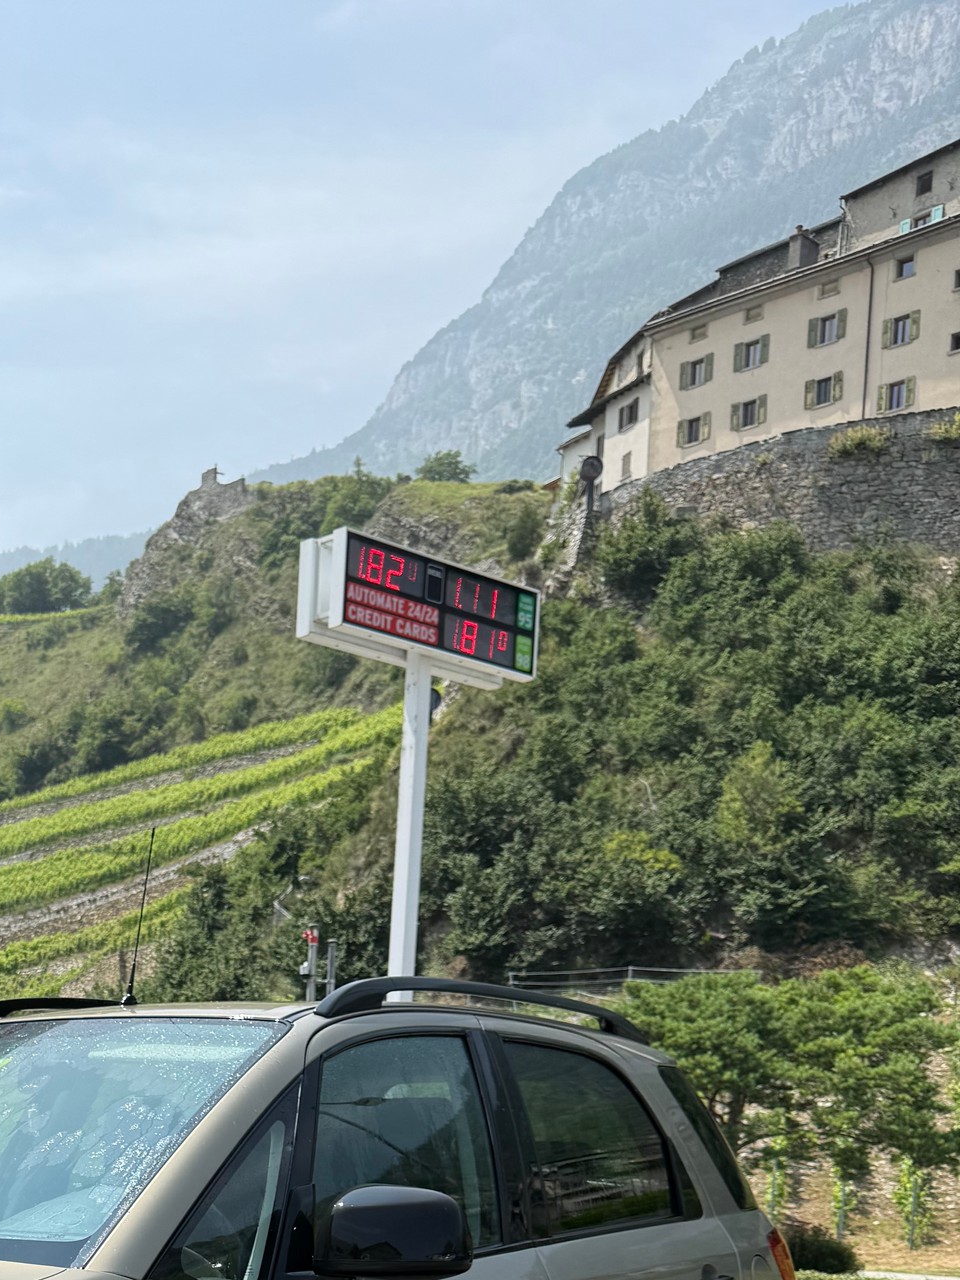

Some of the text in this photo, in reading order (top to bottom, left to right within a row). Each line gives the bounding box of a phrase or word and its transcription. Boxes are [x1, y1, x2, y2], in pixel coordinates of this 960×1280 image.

[347, 584, 439, 625] AUTOMATE 24/24
[518, 612, 533, 629] 95
[348, 605, 436, 643] CREDIT CARDS
